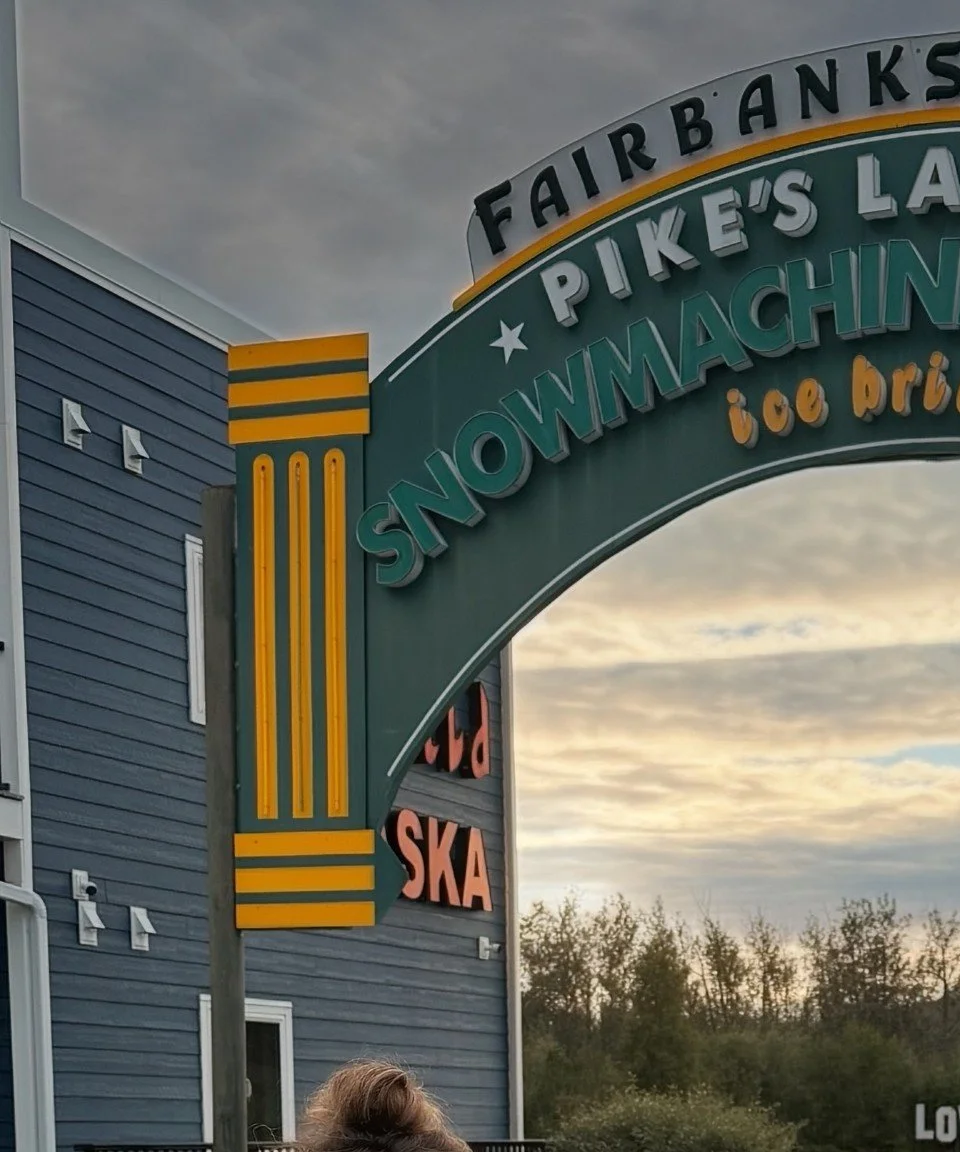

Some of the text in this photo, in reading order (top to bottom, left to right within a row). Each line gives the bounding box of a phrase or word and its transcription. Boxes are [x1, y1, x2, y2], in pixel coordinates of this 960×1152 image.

[540, 169, 818, 327] PIKE'S
[727, 378, 828, 449] ice
[382, 808, 493, 912] SKA
